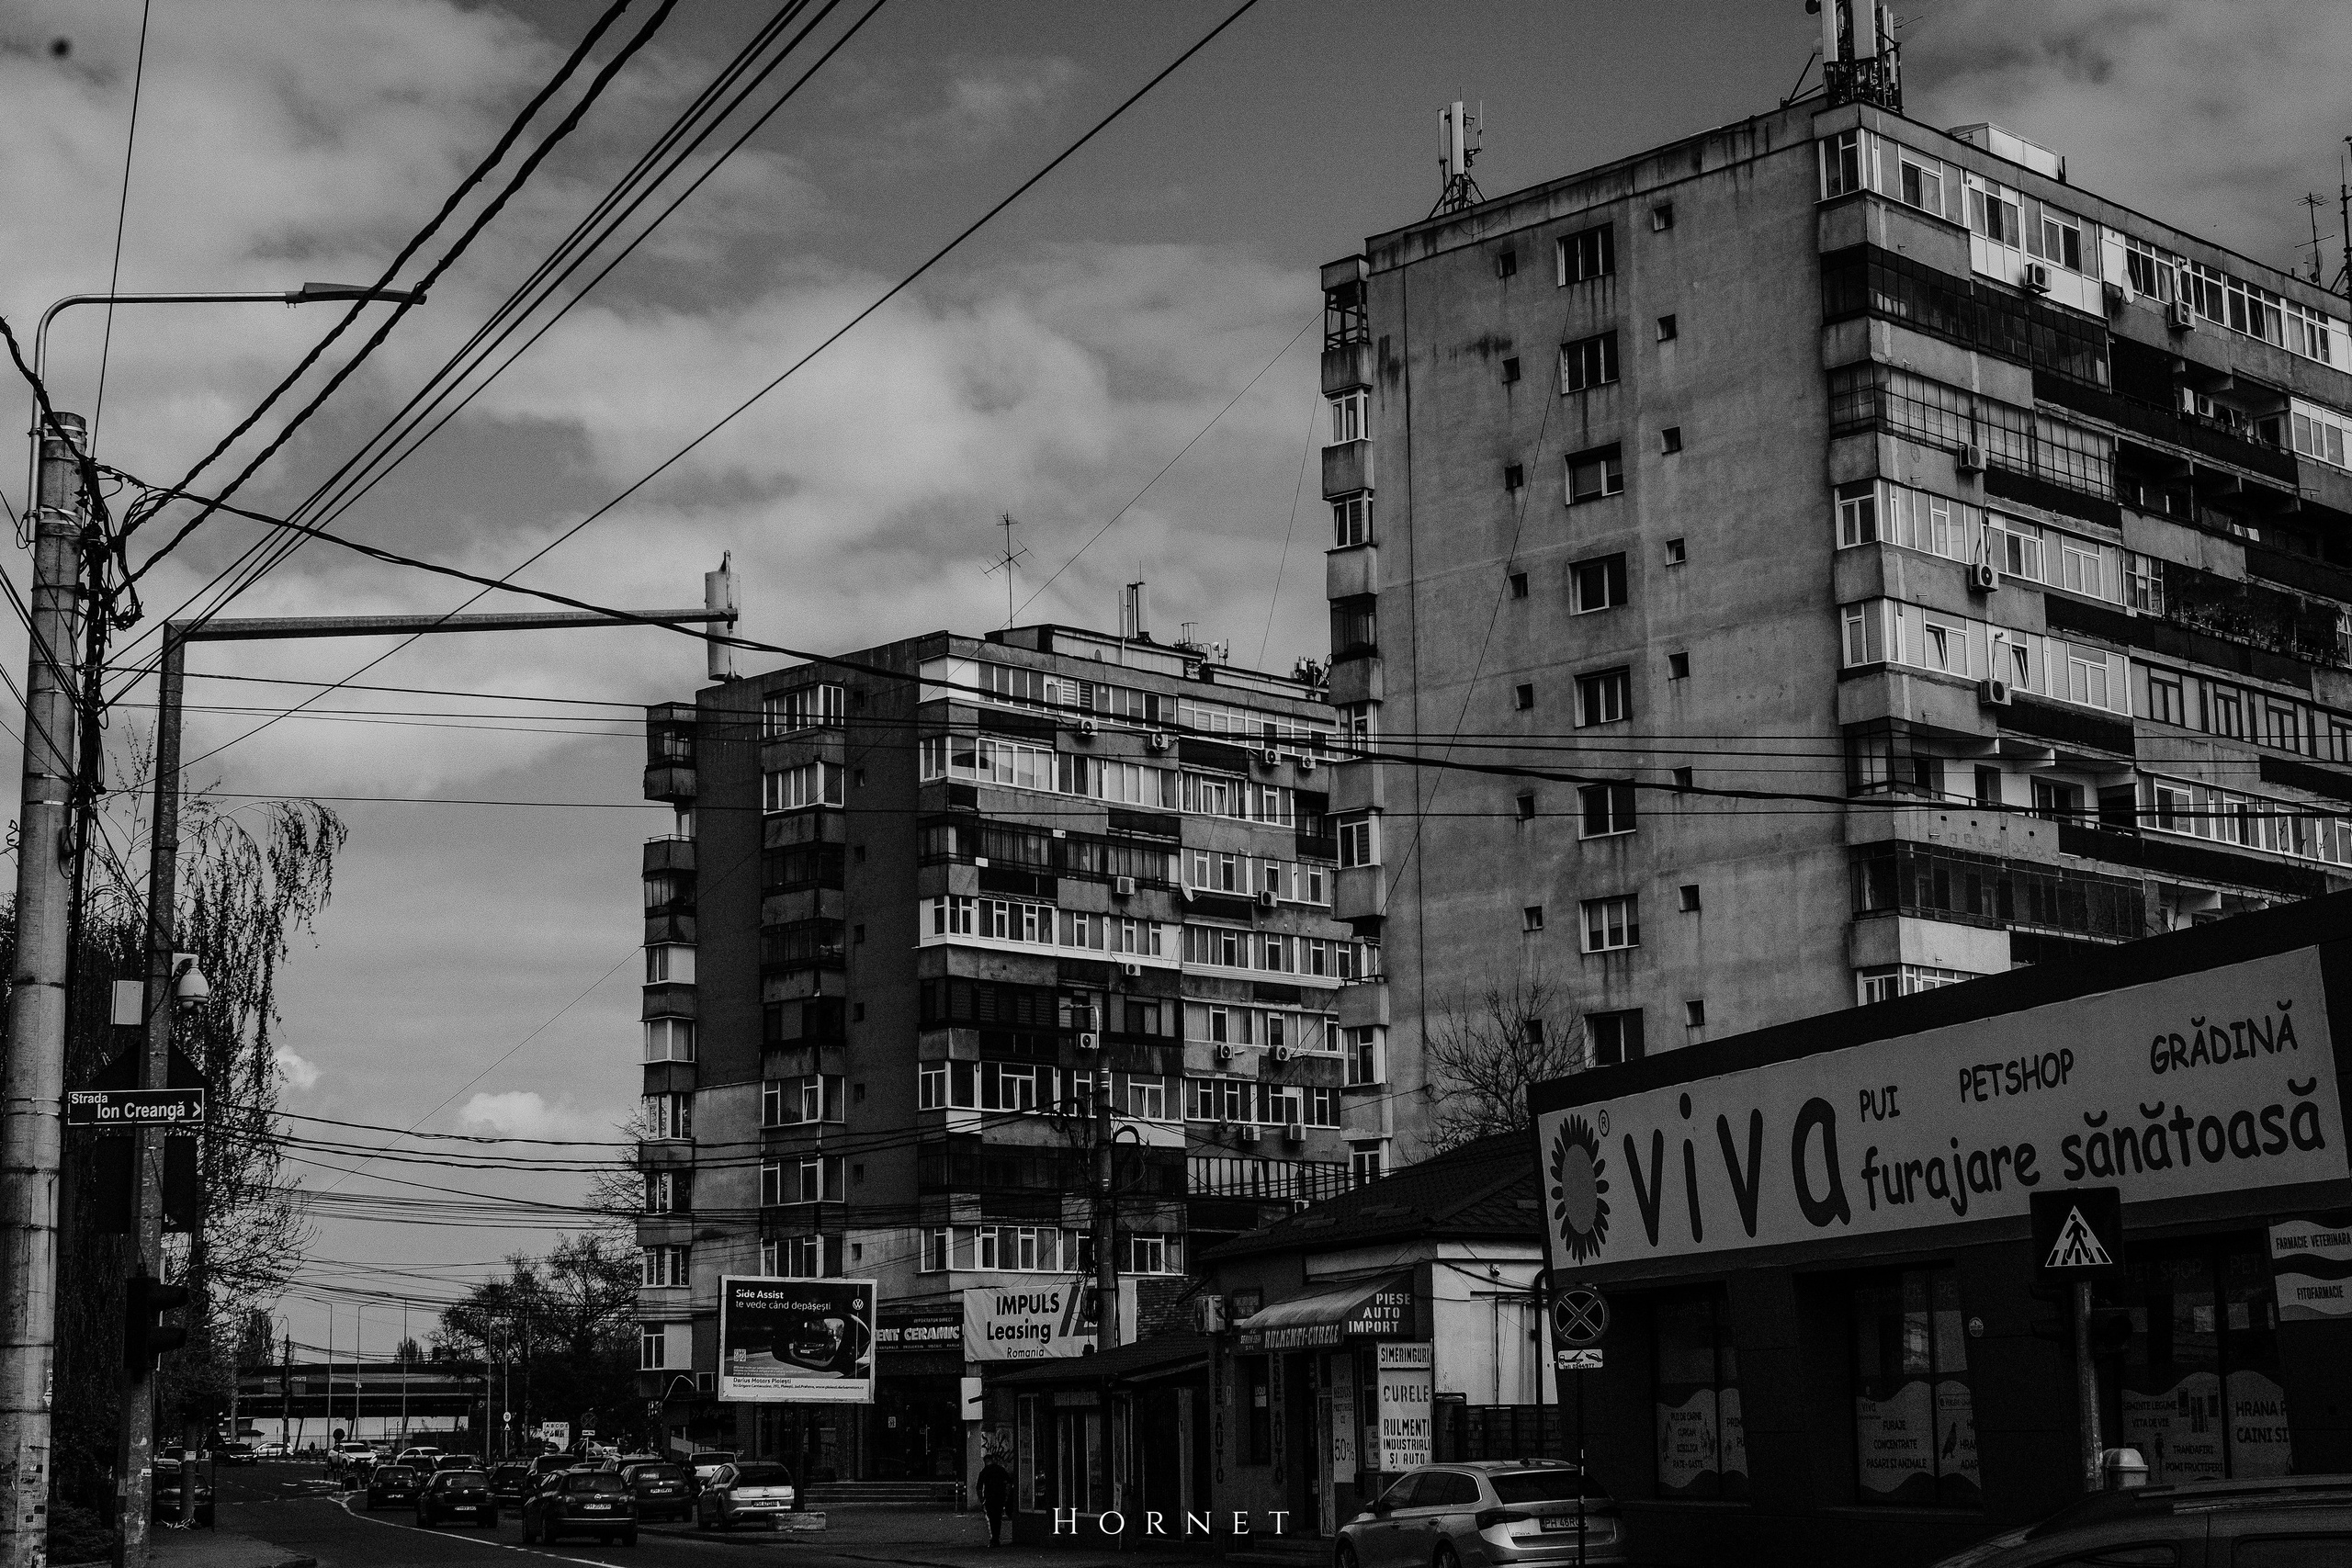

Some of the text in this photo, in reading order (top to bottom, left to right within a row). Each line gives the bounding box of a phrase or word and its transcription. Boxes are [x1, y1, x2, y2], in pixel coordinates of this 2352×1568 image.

[2151, 999, 2297, 1074] GRĂDINĂ
[1959, 1048, 2074, 1102] PETSHOP
[71, 1093, 108, 1104] Strada
[1860, 1086, 1900, 1122] PUI
[96, 1100, 186, 1121] Ion Creangă
[1861, 1077, 2325, 1217] furajare sănătoasă
[1623, 1092, 1850, 1247] viva
[2276, 1232, 2352, 1250] FARMACIE VETERINARA
[735, 1289, 784, 1299] Side Assist
[1375, 1292, 1411, 1305] PIESE
[2296, 1285, 2345, 1300] FITOFARMACIE
[735, 1301, 743, 1309] te
[746, 1301, 767, 1309] vede
[768, 1301, 789, 1310] când
[996, 1292, 1059, 1315] IMPULS
[1363, 1306, 1400, 1319] AUTO
[875, 1325, 959, 1341] ENT CERAMIC
[987, 1318, 1051, 1344] Leasing
[1348, 1320, 1399, 1333] IMPORT
[1007, 1347, 1045, 1359] Romania
[1381, 1347, 1430, 1363] SIMERINGURI
[1383, 1385, 1430, 1403] CURELE
[2151, 1400, 2177, 1410] LEGUME
[2235, 1401, 2278, 1417] HRANA
[1883, 1420, 1906, 1430] FURAJE
[2236, 1427, 2273, 1443] CAINI
[1216, 1412, 1224, 1484] AUTO
[1273, 1410, 1283, 1485] AUTO
[1335, 1438, 1355, 1461] 50%
[1383, 1438, 1430, 1451] INDUSTRIALI
[1873, 1438, 1917, 1450] CONCENTRATE
[2173, 1445, 2214, 1455] TRANDAFIRI
[1403, 1452, 1425, 1465] AUTO
[1898, 1458, 1927, 1469] ANIMALE
[2165, 1462, 2183, 1472] POMI
